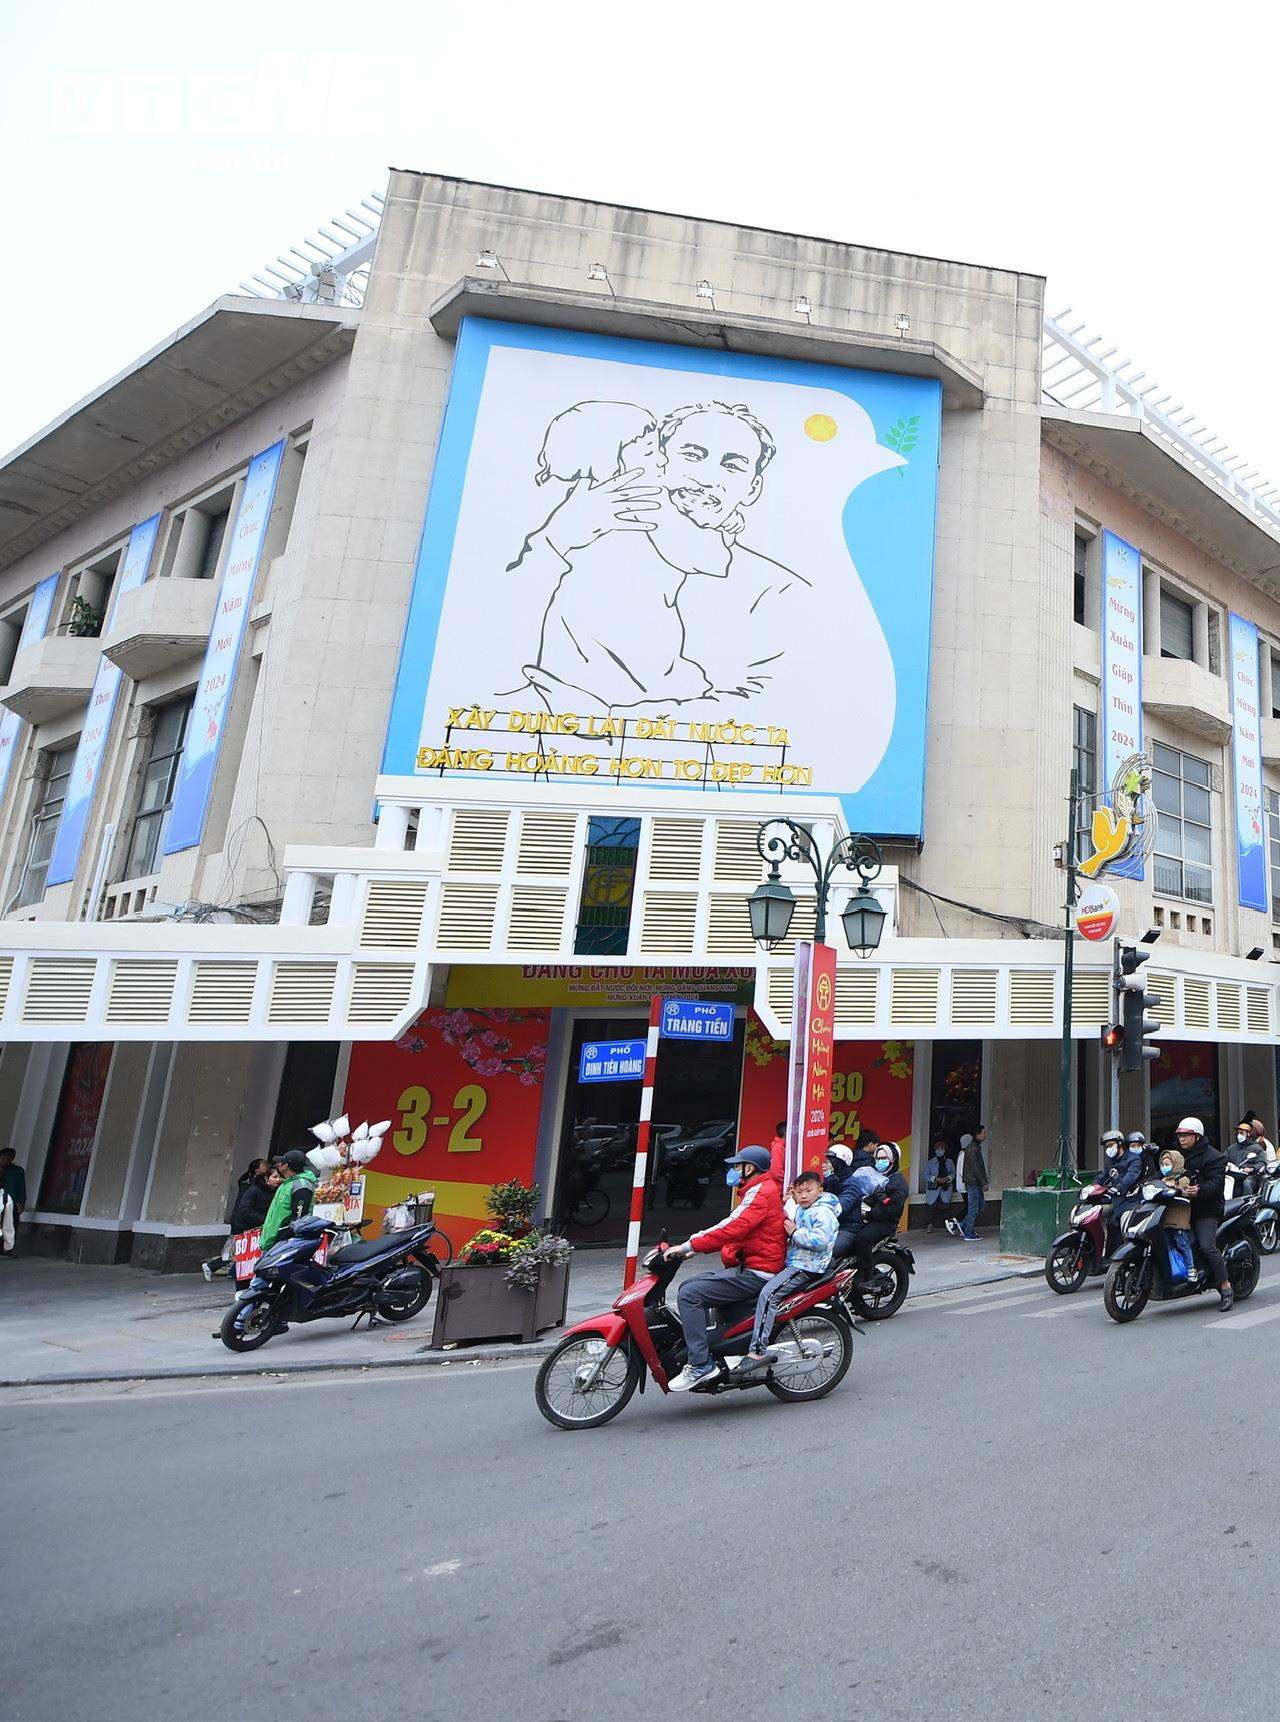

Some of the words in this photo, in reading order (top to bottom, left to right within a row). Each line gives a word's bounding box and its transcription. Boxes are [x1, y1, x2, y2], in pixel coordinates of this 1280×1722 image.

[1108, 597, 1136, 623] Mừng
[1110, 630, 1135, 652] Xuân
[204, 673, 227, 694] 2024
[1111, 663, 1133, 685] Giáp
[446, 703, 497, 730] XÂY
[767, 725, 790, 745] TA
[1111, 730, 1135, 748] 2024
[505, 747, 599, 775] HOÀNG
[673, 759, 703, 780] TO
[711, 761, 753, 788] ĐẸP
[1240, 782, 1258, 799] 2024
[1082, 904, 1104, 914] HDBank
[695, 1004, 717, 1015] PHỐ
[667, 1016, 703, 1034] TRÀNG
[705, 1016, 728, 1035] TIỀN
[610, 1044, 631, 1055] PHỐ
[585, 1062, 602, 1076] ĐINH
[603, 1059, 618, 1075] TIÊN
[619, 1057, 642, 1074] HOÀNG
[392, 1084, 487, 1155] 3-2
[810, 1108, 825, 1123] 2024
